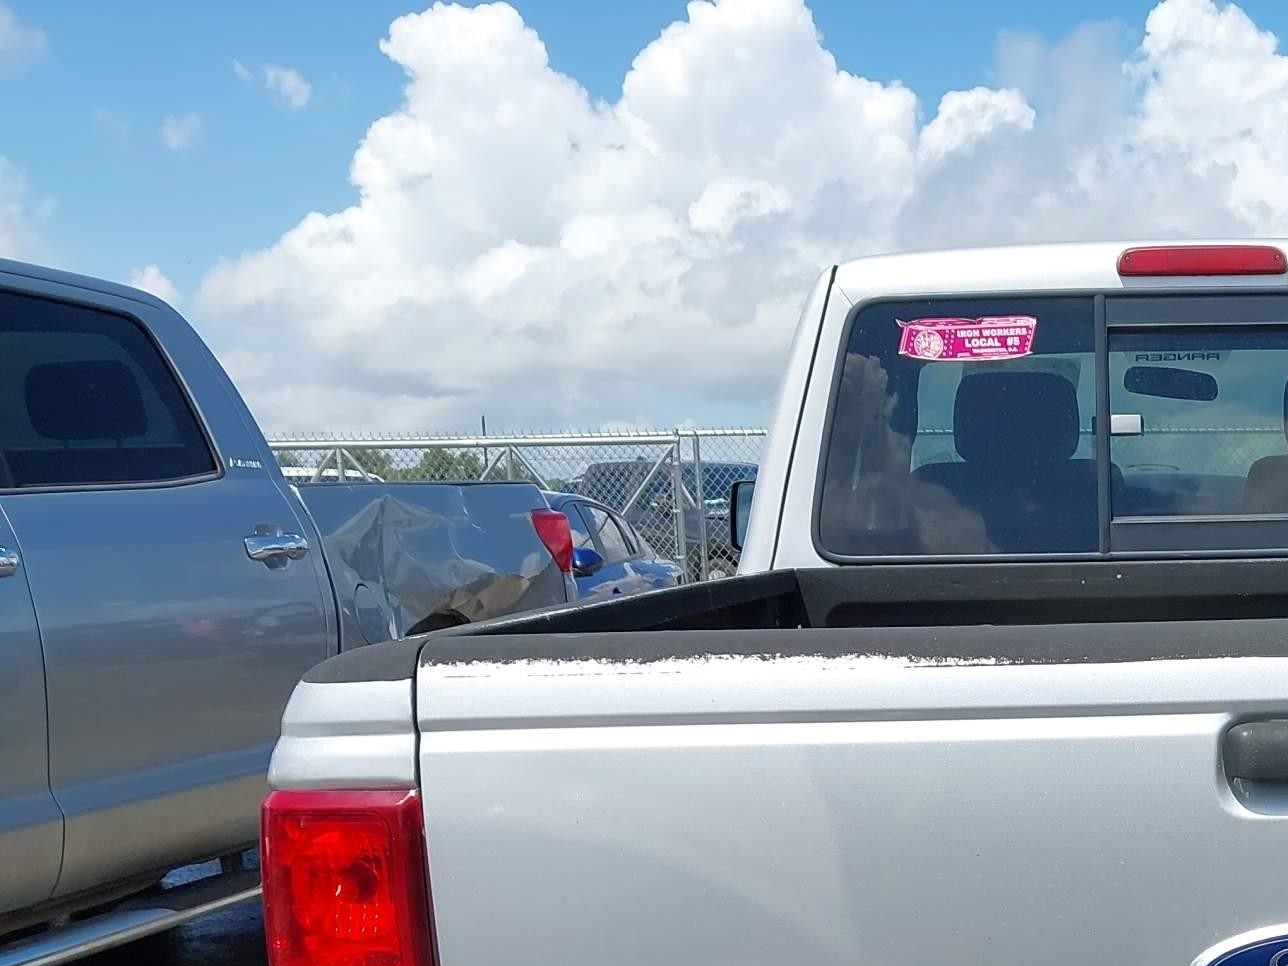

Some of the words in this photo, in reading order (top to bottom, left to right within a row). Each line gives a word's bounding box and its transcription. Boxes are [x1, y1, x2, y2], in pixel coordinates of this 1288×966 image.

[957, 330, 980, 338] IRON
[982, 328, 1028, 337] WORKERS
[965, 337, 1001, 347] LOCAL
[1006, 337, 1020, 346] #5
